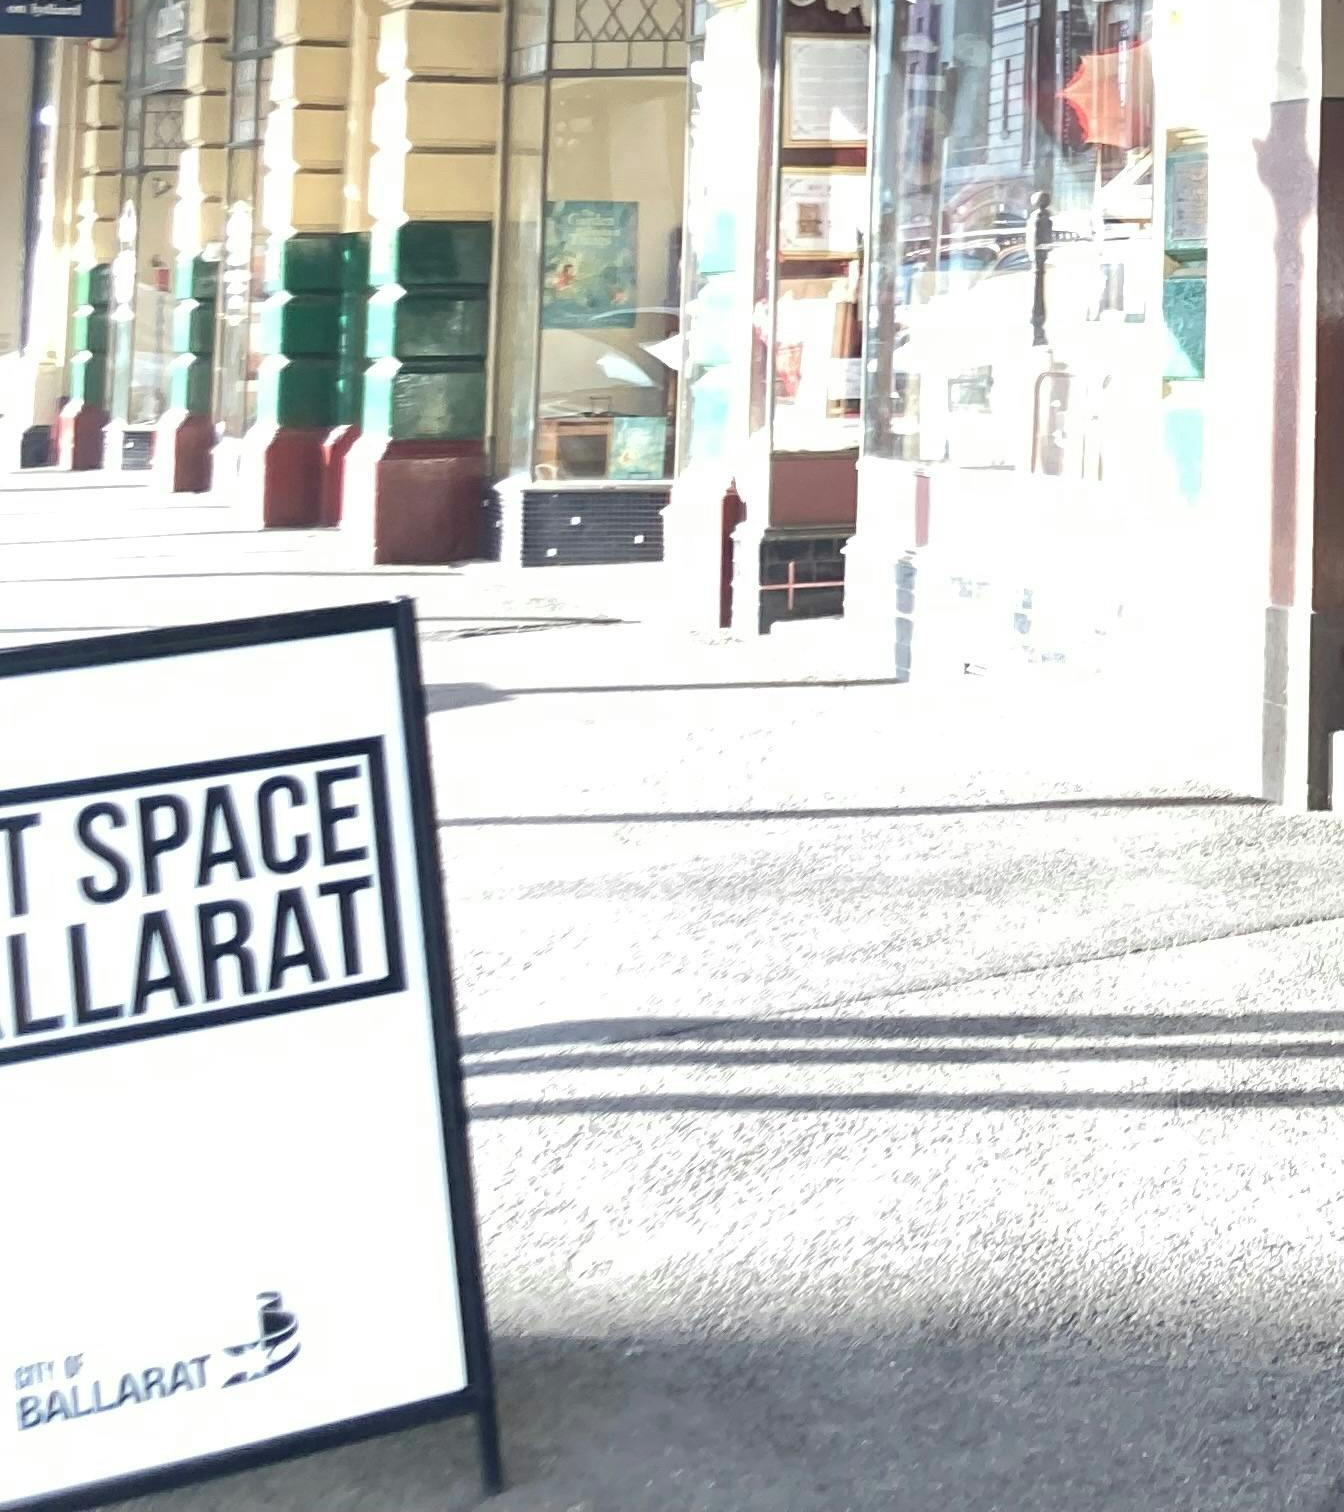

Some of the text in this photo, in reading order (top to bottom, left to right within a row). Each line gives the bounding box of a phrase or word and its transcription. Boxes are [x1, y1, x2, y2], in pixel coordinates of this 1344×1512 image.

[76, 763, 370, 907] SPACE
[0, 874, 374, 1039] LLARAT
[18, 1354, 212, 1431] BALLARAT
